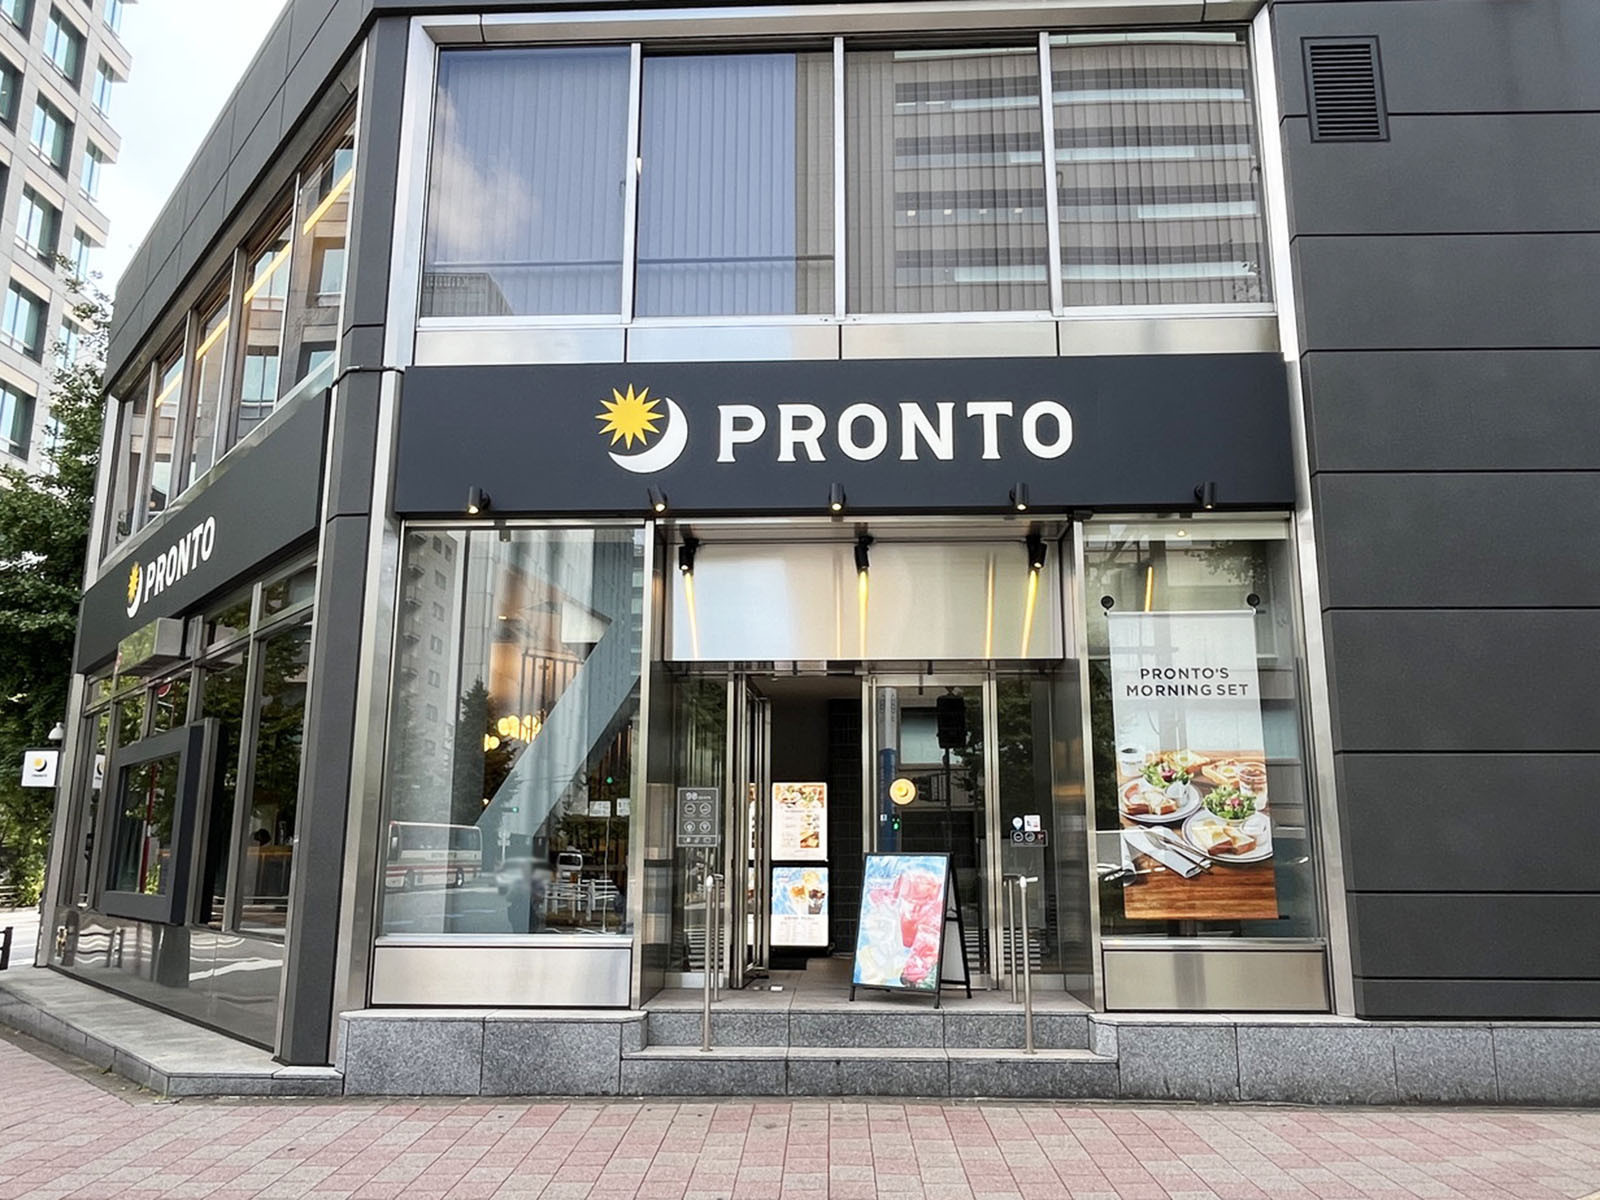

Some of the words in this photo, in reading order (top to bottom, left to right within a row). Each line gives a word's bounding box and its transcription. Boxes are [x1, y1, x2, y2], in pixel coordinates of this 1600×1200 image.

[717, 400, 1073, 463] PRONTO
[143, 516, 216, 604] PRONTO
[1126, 684, 1212, 697] MORNING
[1216, 683, 1249, 696] SET
[1140, 667, 1229, 680] PRONTO'S
